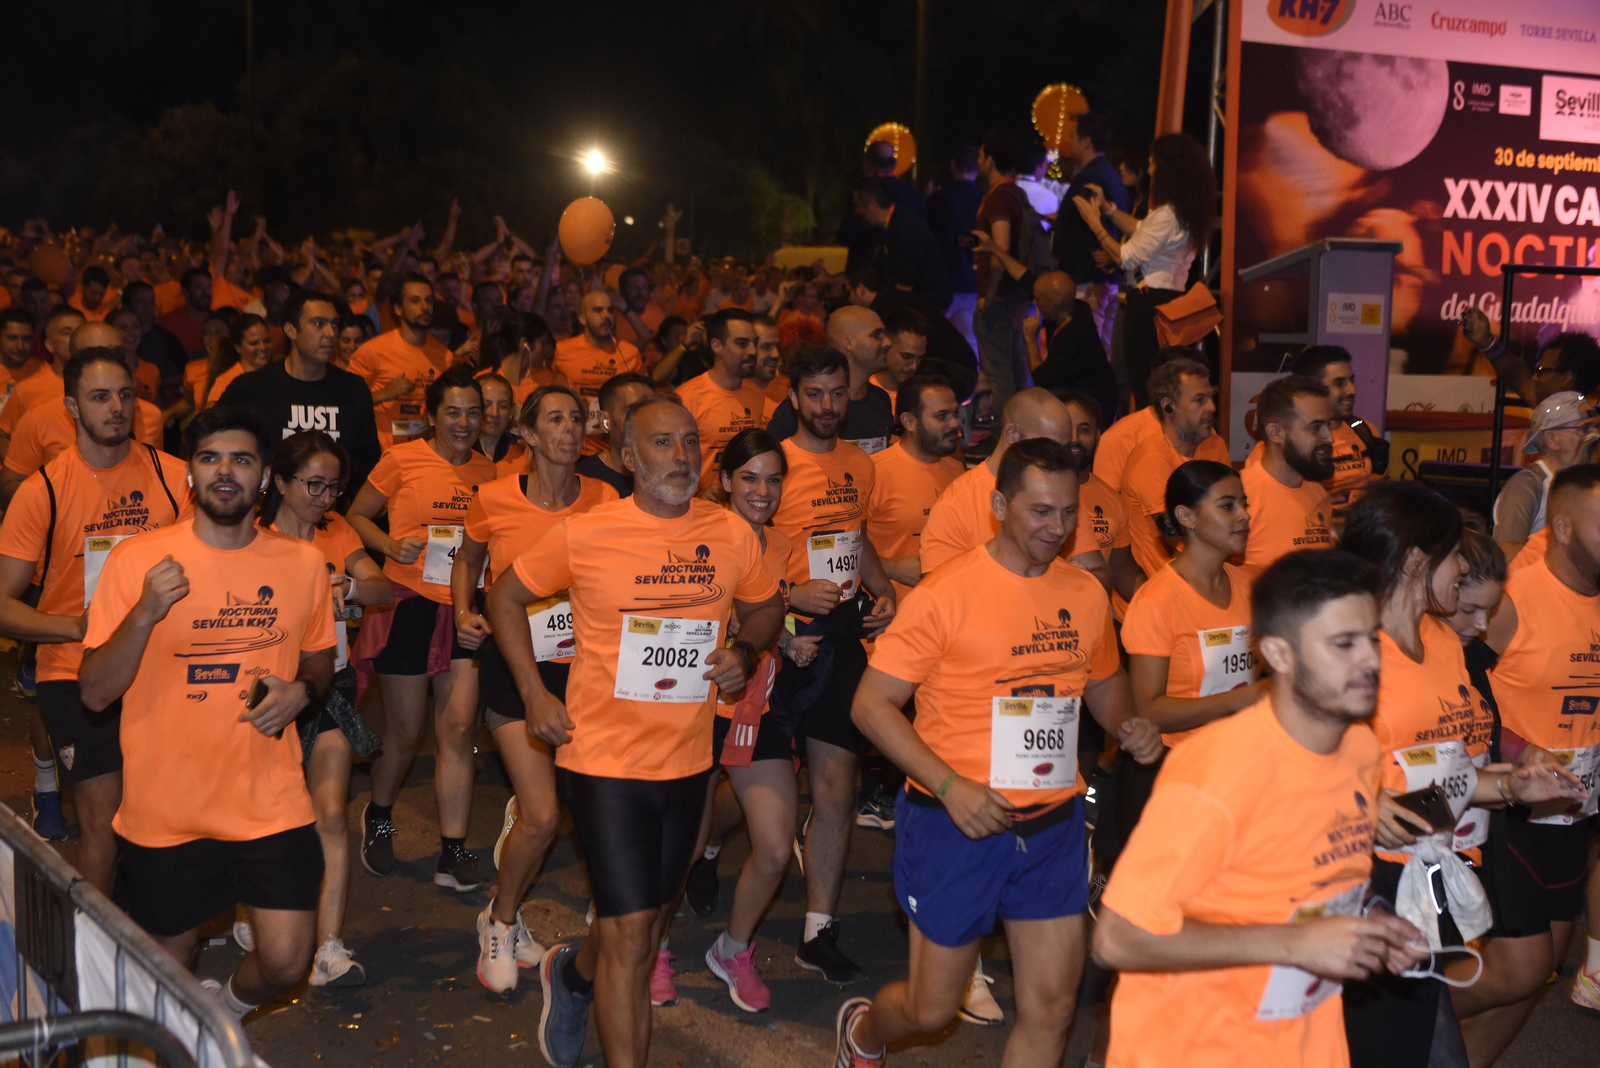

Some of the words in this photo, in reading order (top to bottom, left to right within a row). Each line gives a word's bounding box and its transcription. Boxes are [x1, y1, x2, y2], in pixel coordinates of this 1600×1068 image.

[1375, 3, 1412, 22] ABC
[1431, 11, 1508, 37] Cruzcampo
[1520, 24, 1553, 39] TORRE
[1555, 27, 1597, 43] SEVILLA
[1472, 82, 1491, 96] IMD
[1494, 147, 1514, 166] 30
[1515, 149, 1536, 168] de
[1442, 177, 1553, 223] XXXIV
[1342, 302, 1356, 312] IMD
[1440, 292, 1476, 322] del
[288, 404, 340, 431] JUST
[1437, 447, 1468, 464] IMD
[826, 488, 858, 497] NOCTURNA
[432, 501, 468, 510] SEVILLA
[811, 496, 842, 507] SEVILLA
[103, 508, 150, 520] NOCTURNA
[84, 519, 123, 533] SEVILLA
[661, 565, 716, 574] NOCTURNA
[826, 553, 858, 573] 14921
[634, 575, 686, 585] SEVILLA
[218, 608, 279, 618] NOCTURNA
[192, 618, 245, 630] SEVILLA
[1032, 630, 1079, 642] NOCTURNA
[1011, 641, 1055, 656] SEVILLA
[642, 646, 699, 668] 20082
[1024, 729, 1065, 751] 9668
